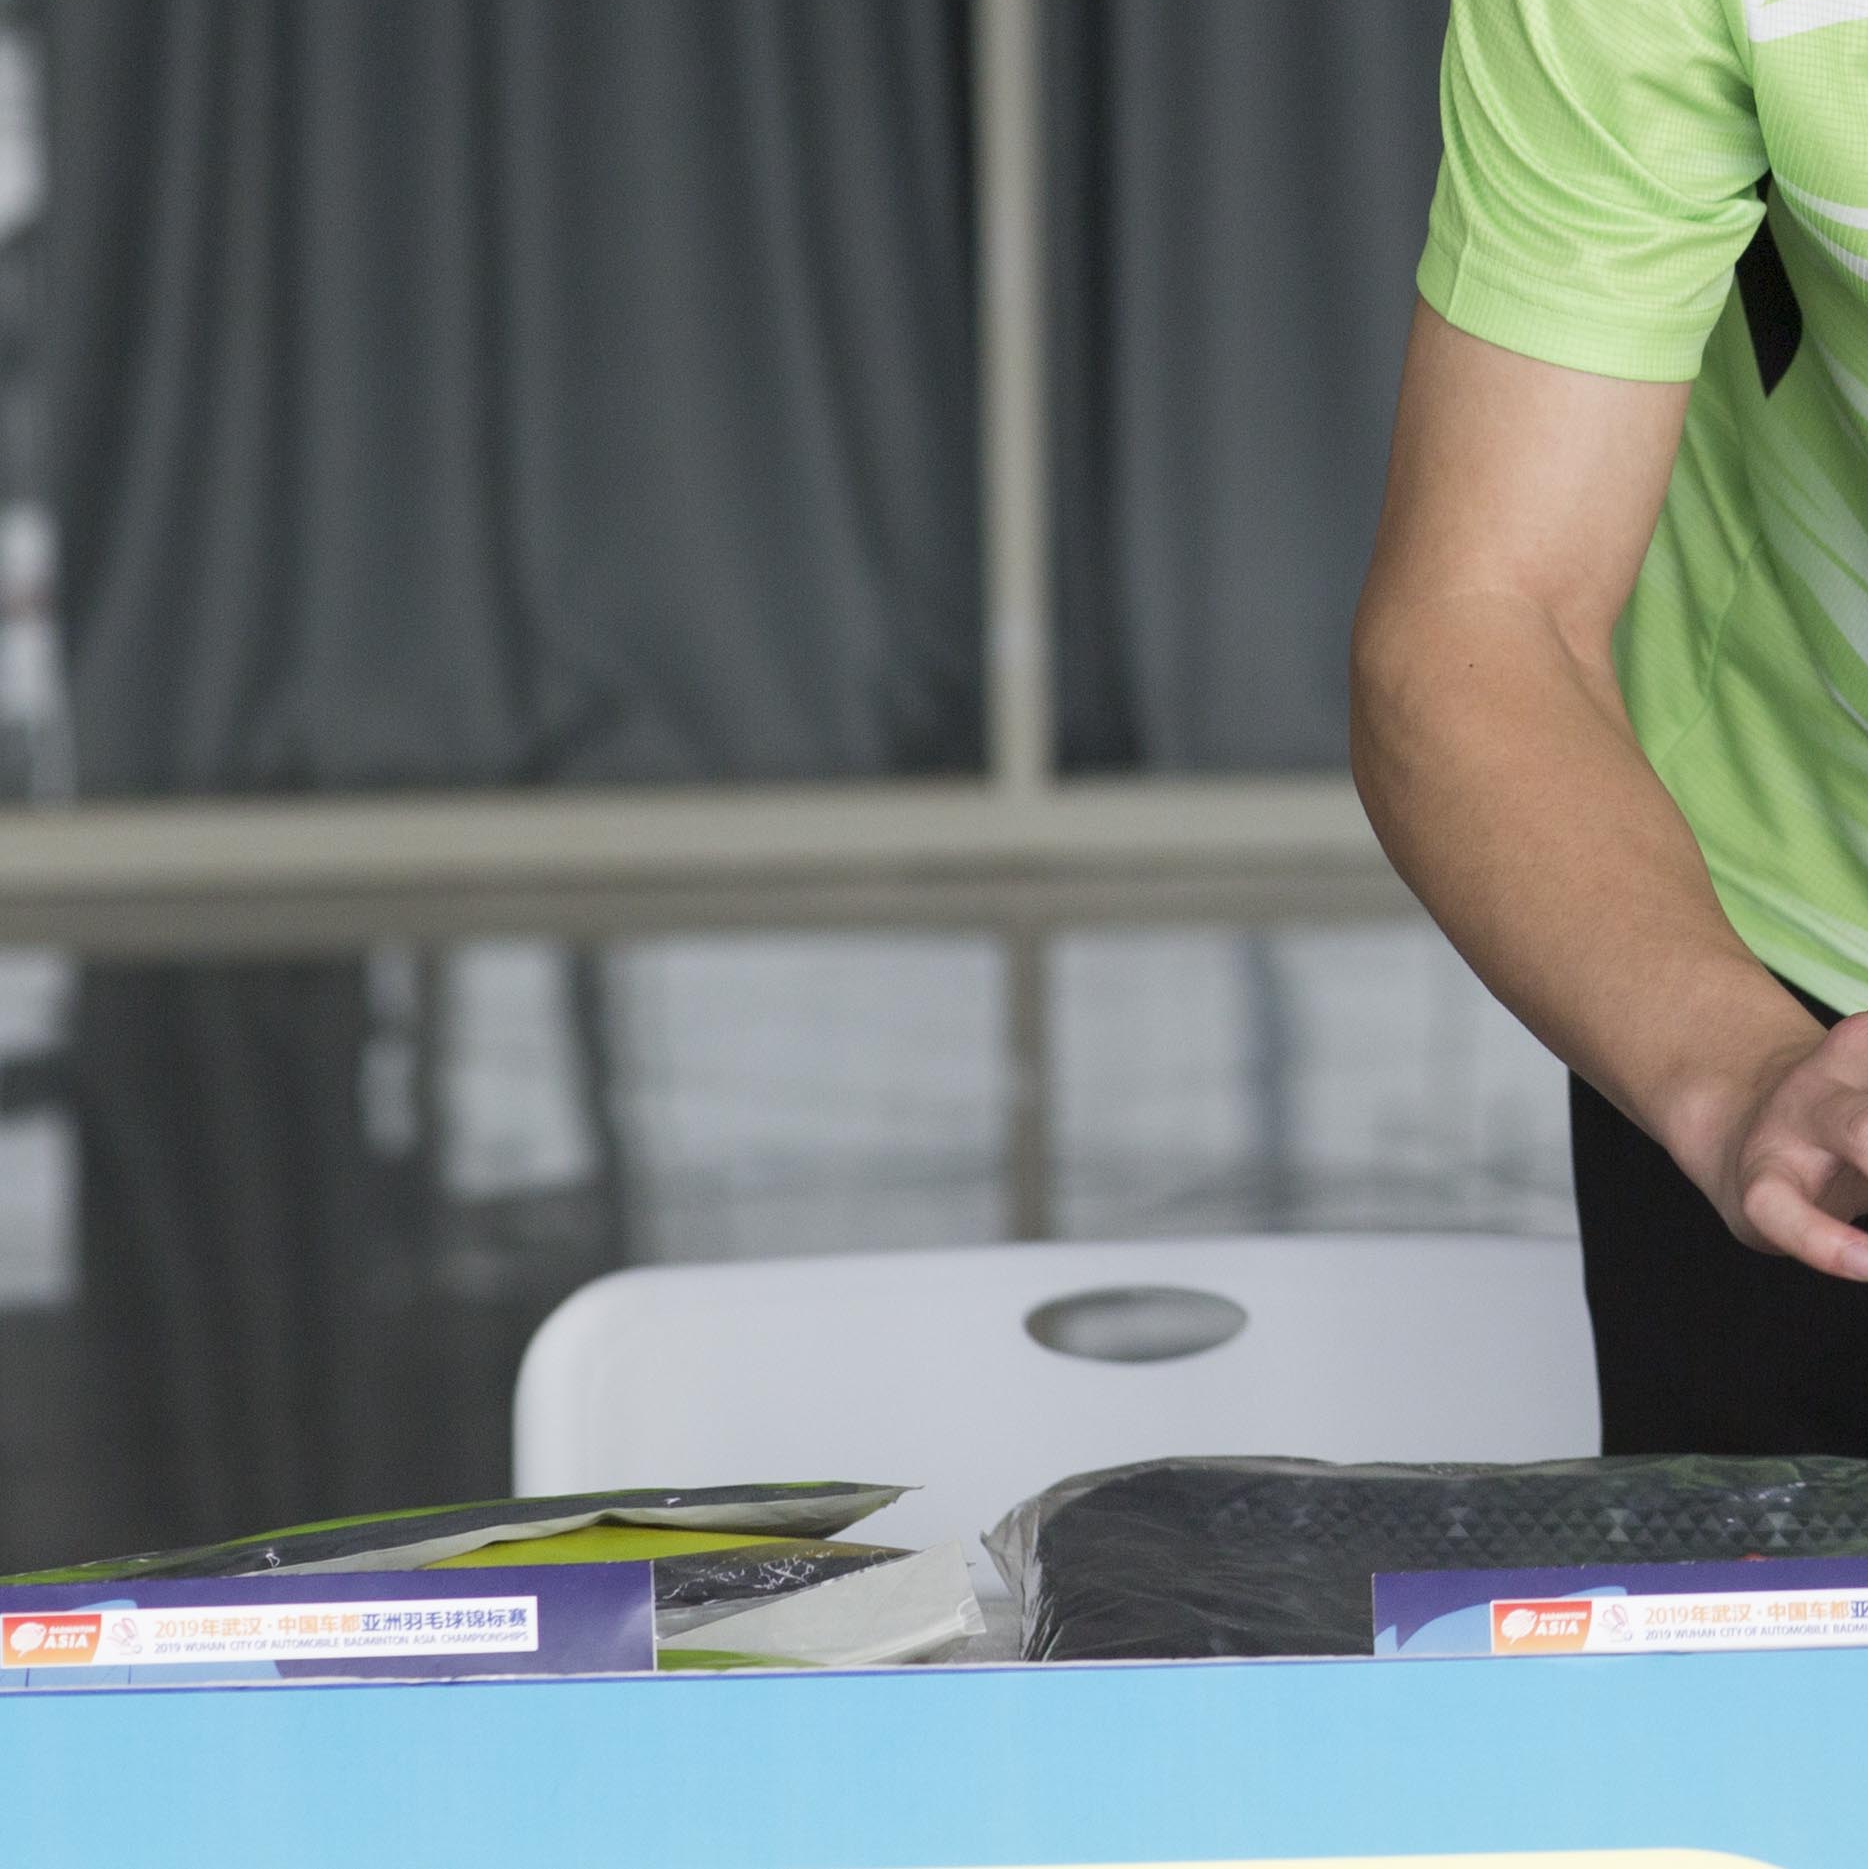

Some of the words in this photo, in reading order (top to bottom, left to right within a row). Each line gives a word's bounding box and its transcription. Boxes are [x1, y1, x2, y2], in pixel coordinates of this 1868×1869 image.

[1535, 1621, 1579, 1637] ASIA
[1645, 1630, 1671, 1641] 2019
[1675, 1628, 1716, 1639] WUHAN
[1720, 1626, 1743, 1637] CITY
[1744, 1626, 1758, 1636] OF
[1760, 1623, 1828, 1635] AUTOMOBILE
[43, 1634, 89, 1650] ASIA
[154, 1642, 182, 1655] 2019
[185, 1640, 226, 1652] WUHAN
[230, 1639, 250, 1650] CITY
[252, 1639, 267, 1650] OF
[270, 1636, 340, 1650] AUTOMOBILE
[343, 1635, 410, 1647] BADMINTON
[413, 1634, 436, 1644] ASIA
[440, 1631, 529, 1643] CHAMPIONSHIPS
